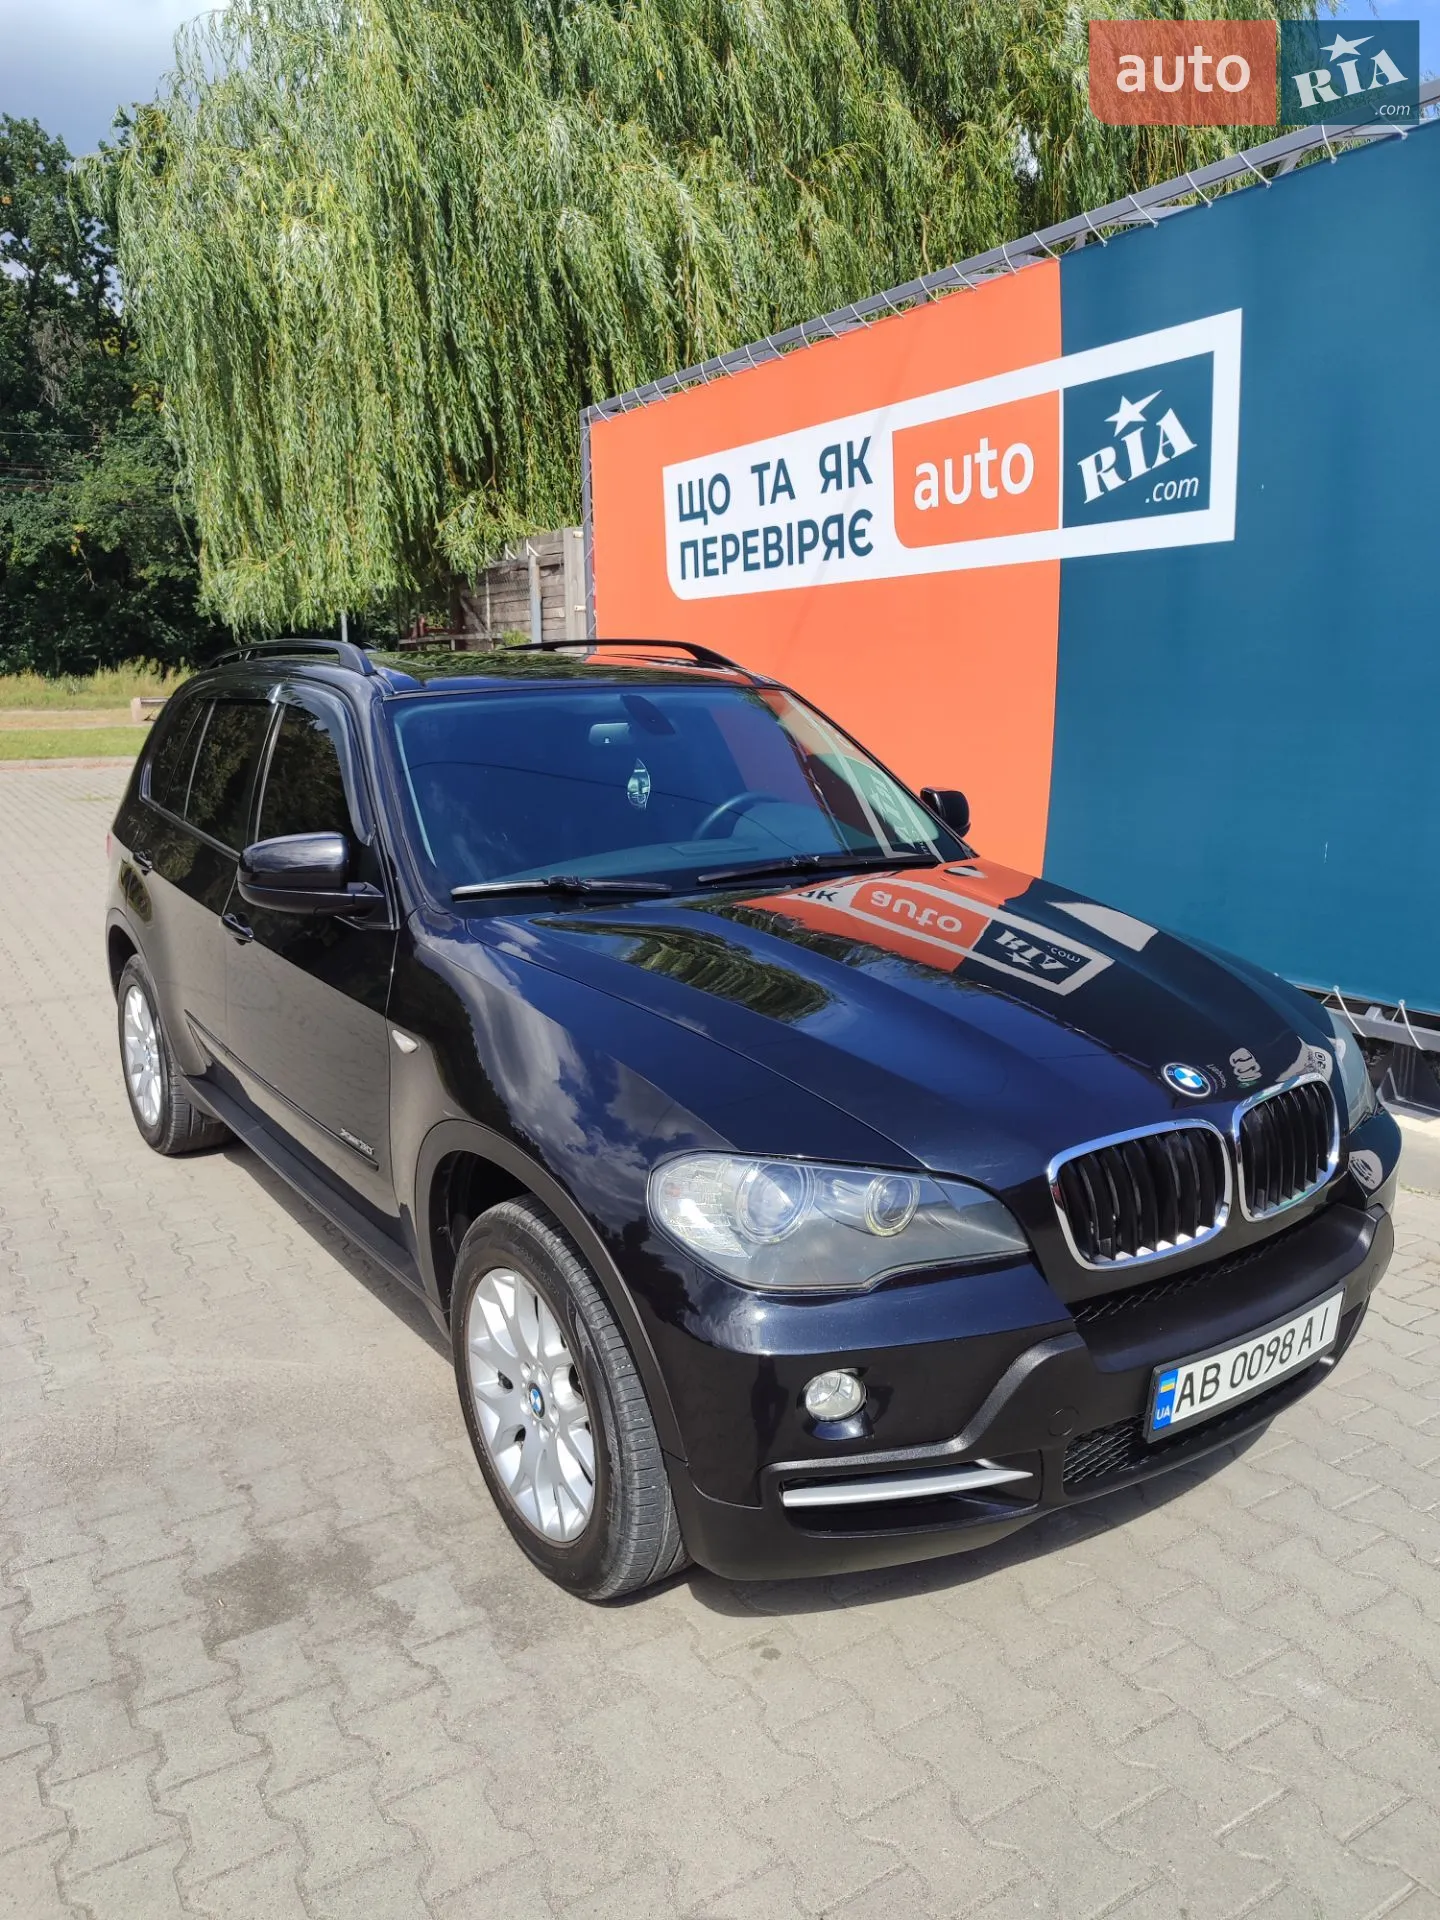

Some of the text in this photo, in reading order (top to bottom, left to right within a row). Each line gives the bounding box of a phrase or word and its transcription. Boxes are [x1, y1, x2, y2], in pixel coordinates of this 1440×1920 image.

[677, 436, 874, 526] ЩО ТА ЯК
[913, 407, 1198, 511] auto RIA
[1144, 477, 1199, 504] .com
[679, 508, 874, 581] ПЕРЕВІРЯЄ
[1175, 1362, 1221, 1414] AB
[1229, 1328, 1296, 1389] 0098
[1155, 1405, 1171, 1421] UA
